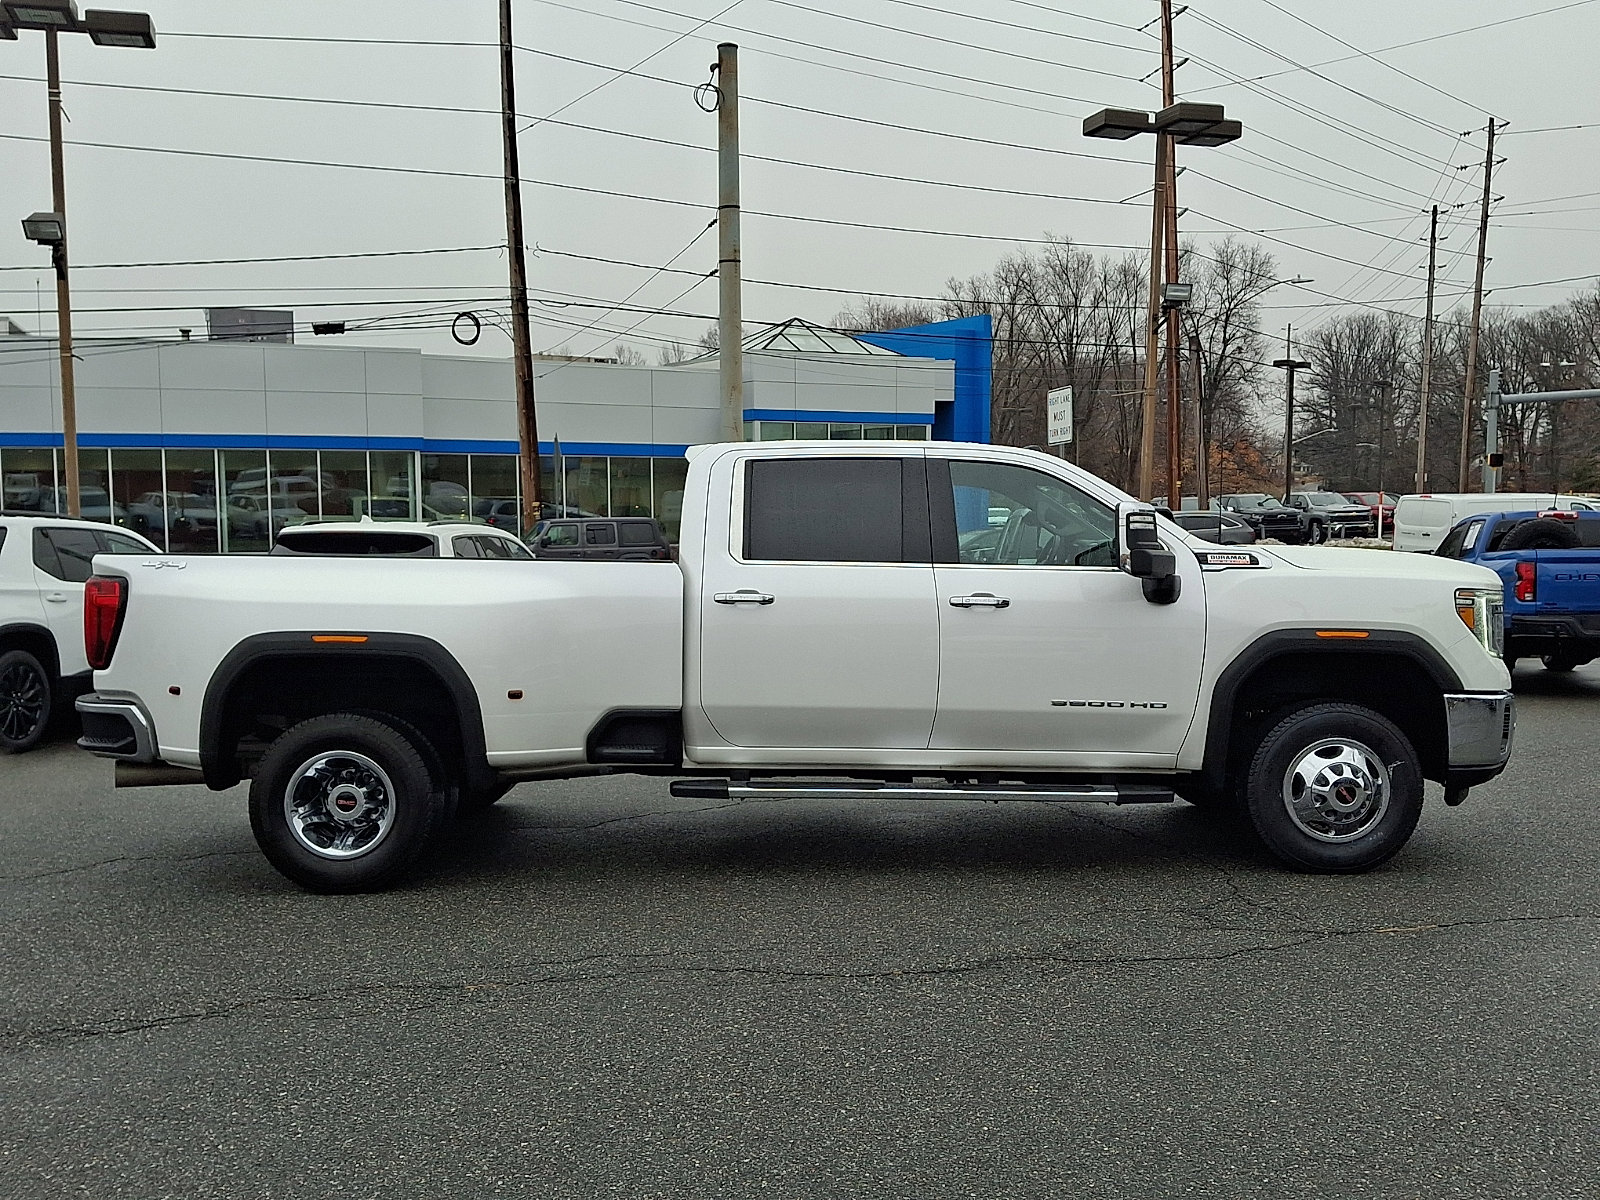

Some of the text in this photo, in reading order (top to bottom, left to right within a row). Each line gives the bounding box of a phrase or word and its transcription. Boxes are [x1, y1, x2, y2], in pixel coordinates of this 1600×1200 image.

[1060, 394, 1071, 404] LANE
[1053, 410, 1066, 422] MUST
[1049, 426, 1071, 438] TURN RIGHT
[1130, 701, 1168, 709] HD
